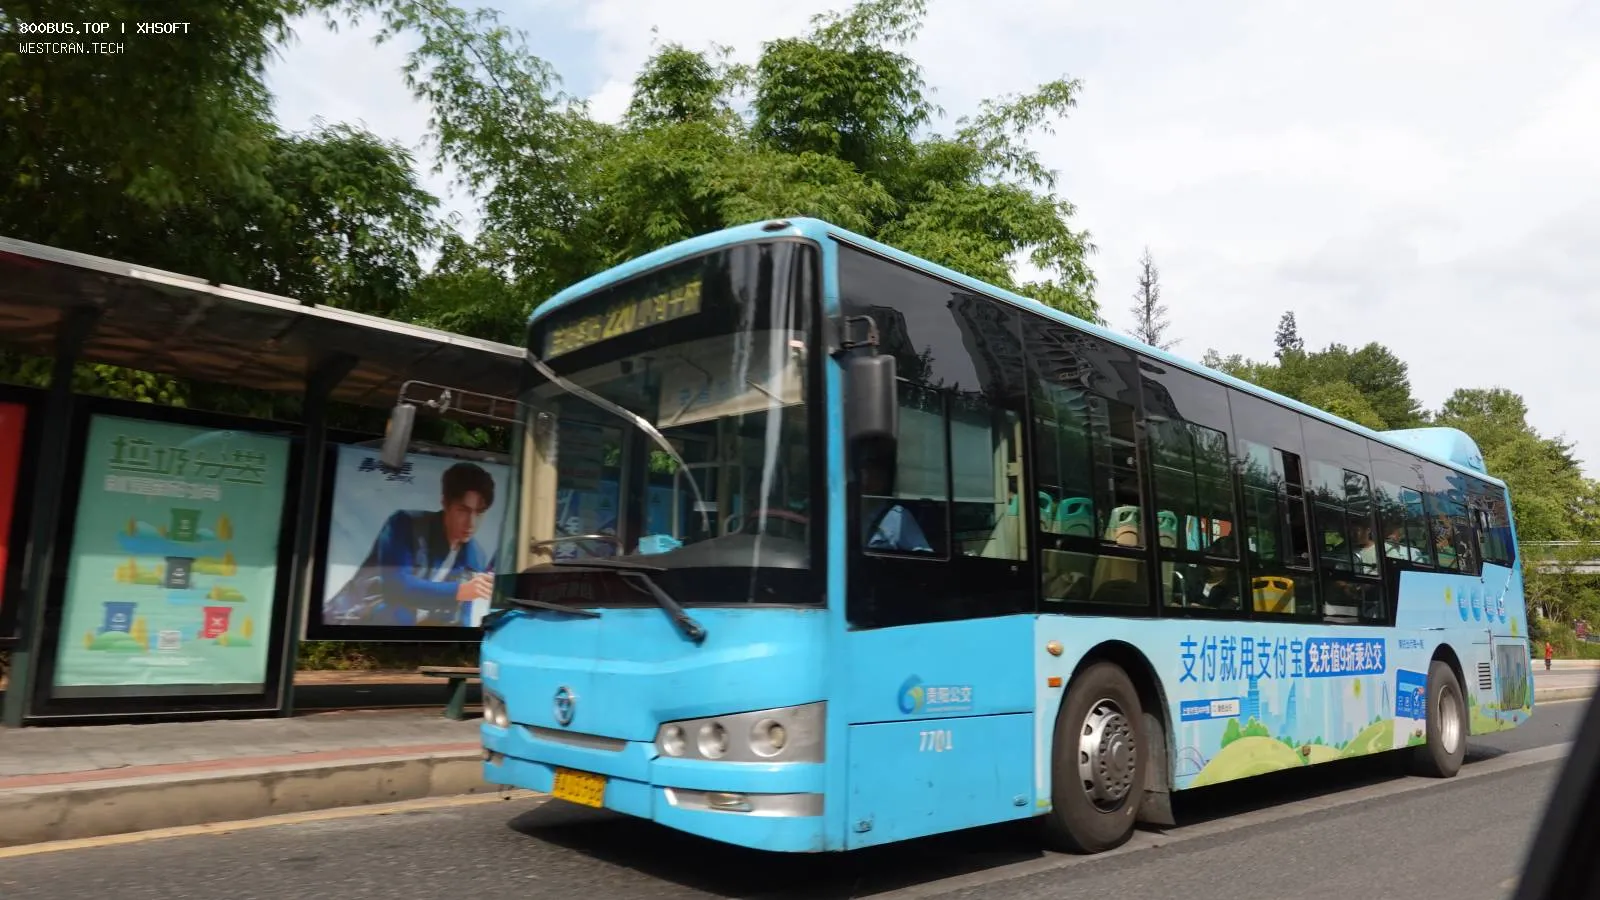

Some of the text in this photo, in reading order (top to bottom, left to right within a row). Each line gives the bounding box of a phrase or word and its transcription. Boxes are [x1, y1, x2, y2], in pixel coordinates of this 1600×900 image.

[1179, 635, 1383, 682] 支付就用支付宝 免充值9折乘公交
[919, 729, 953, 752] 7701
